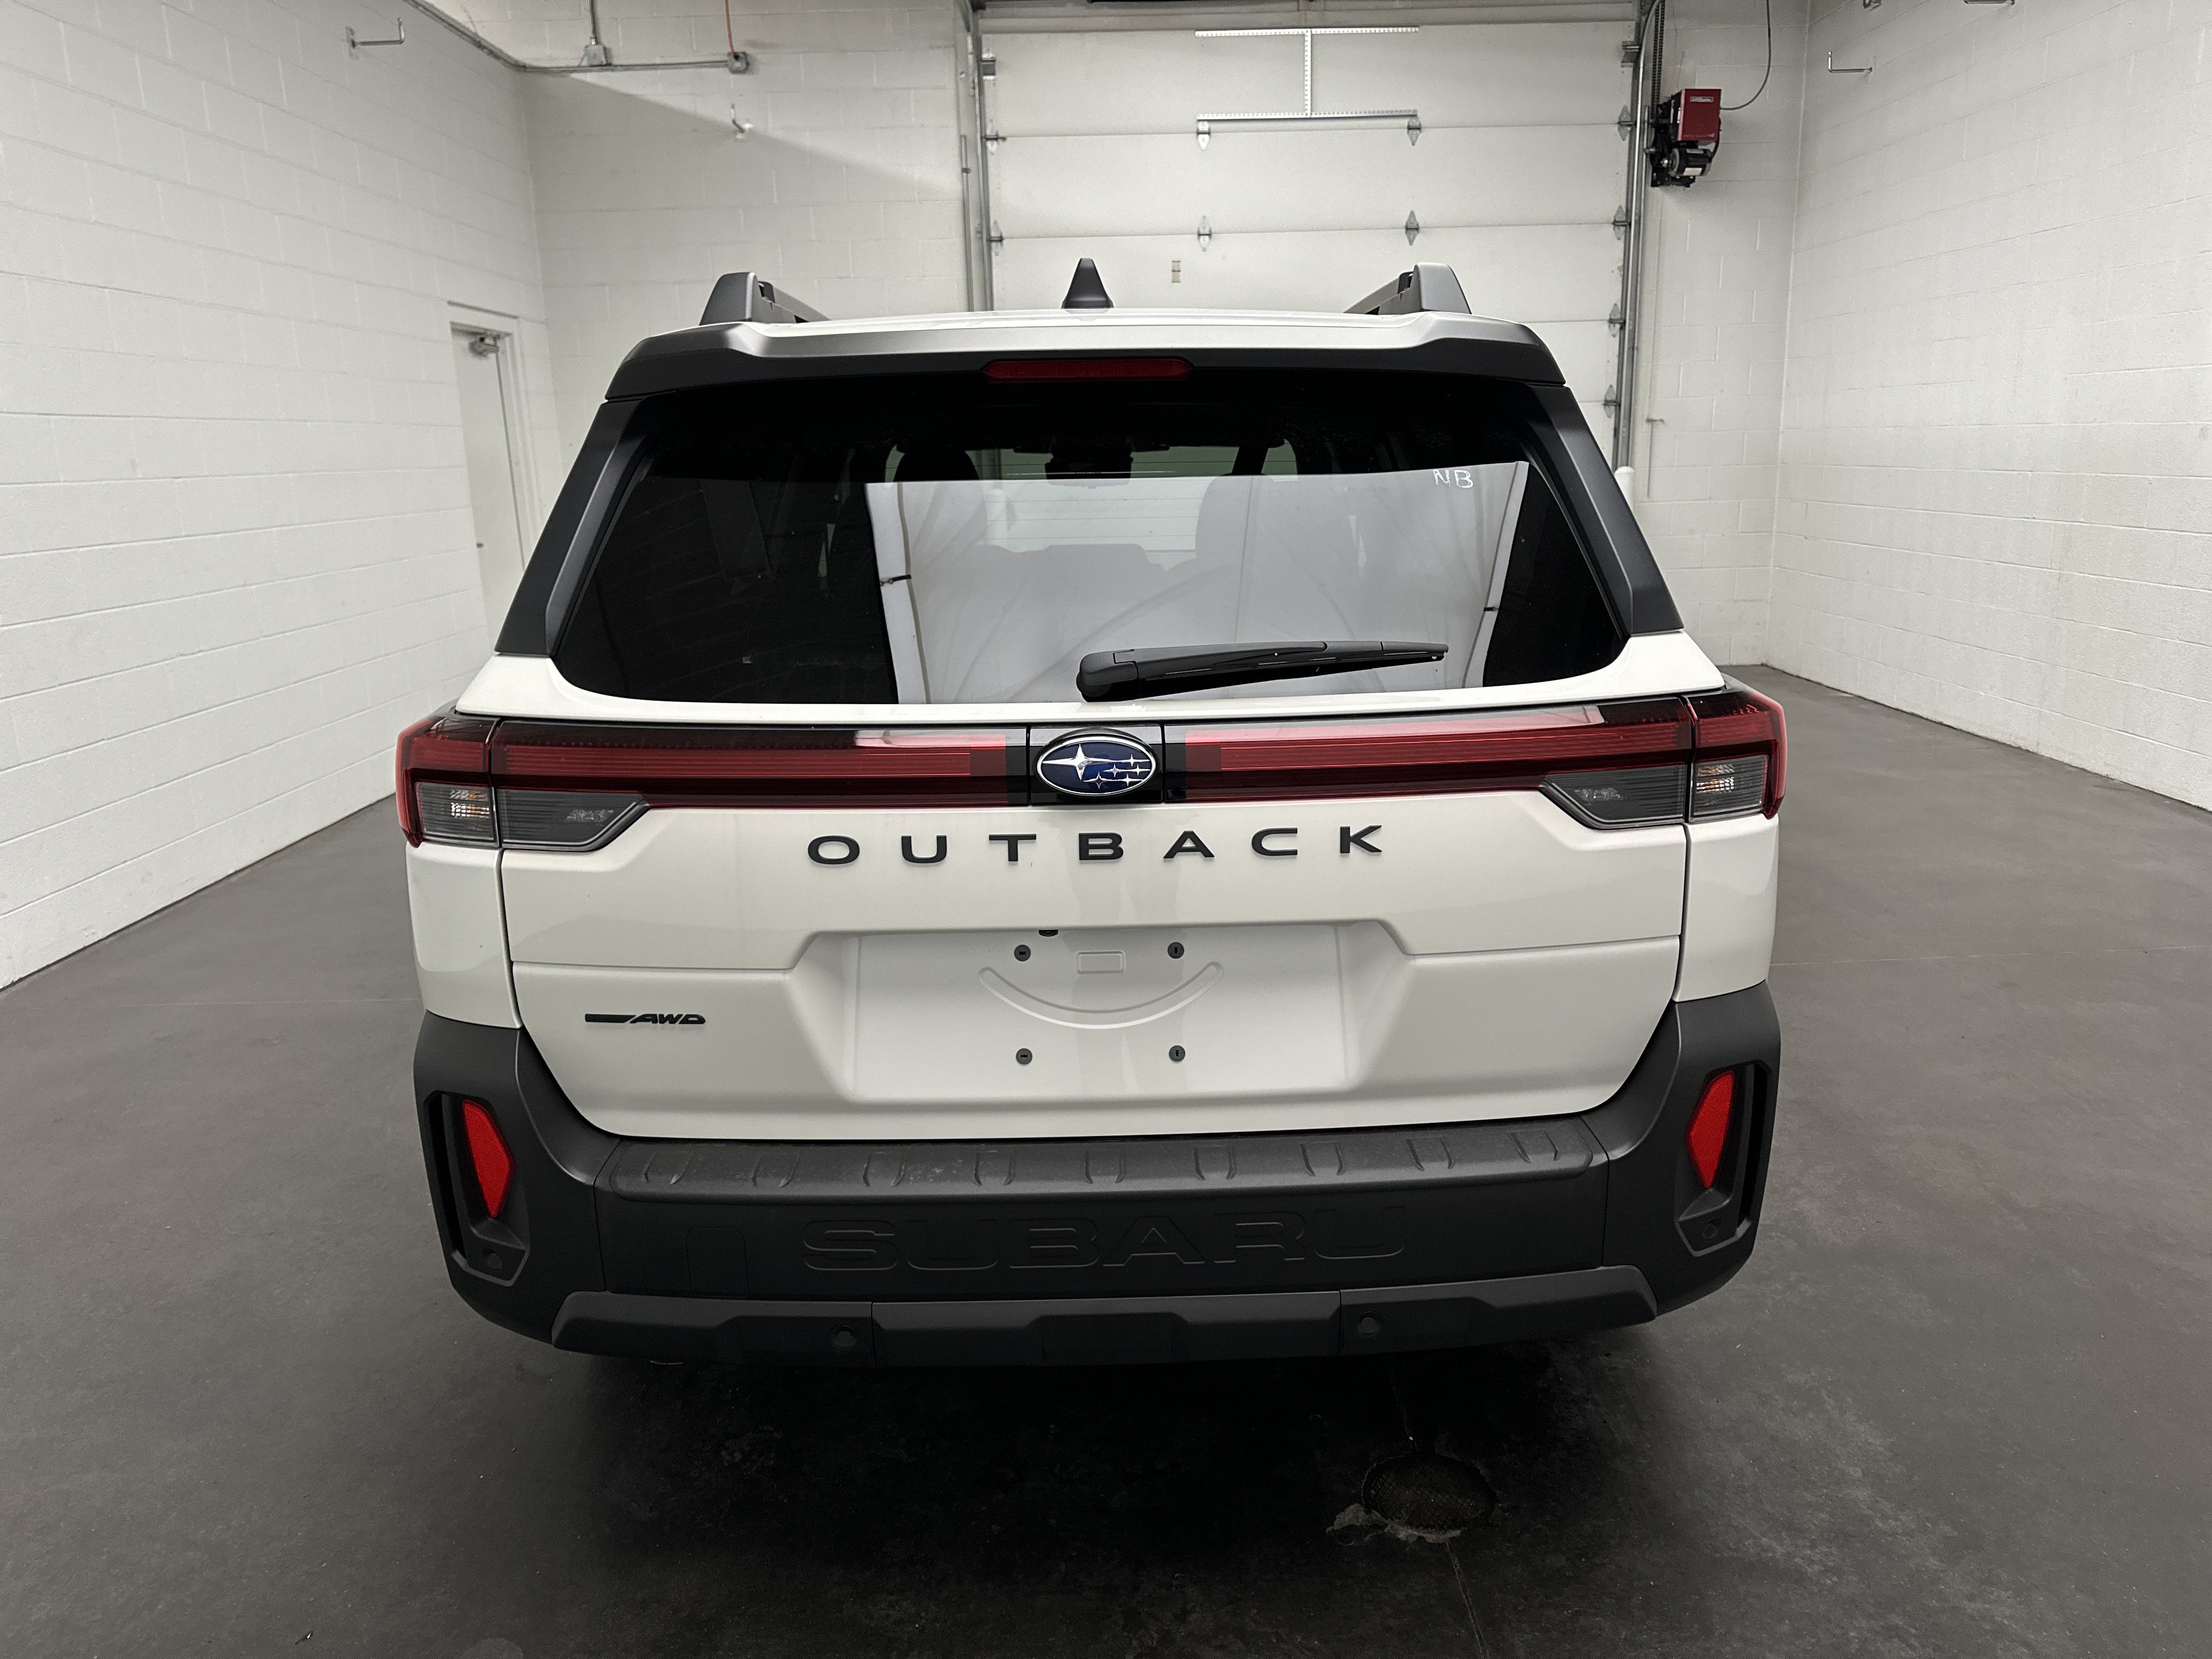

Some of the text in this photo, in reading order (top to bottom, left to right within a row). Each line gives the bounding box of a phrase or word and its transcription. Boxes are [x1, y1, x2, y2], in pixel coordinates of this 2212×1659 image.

[808, 825, 1383, 865] OUTBACK
[629, 1013, 706, 1025] AWD
[802, 1205, 1407, 1270] SUBARU
